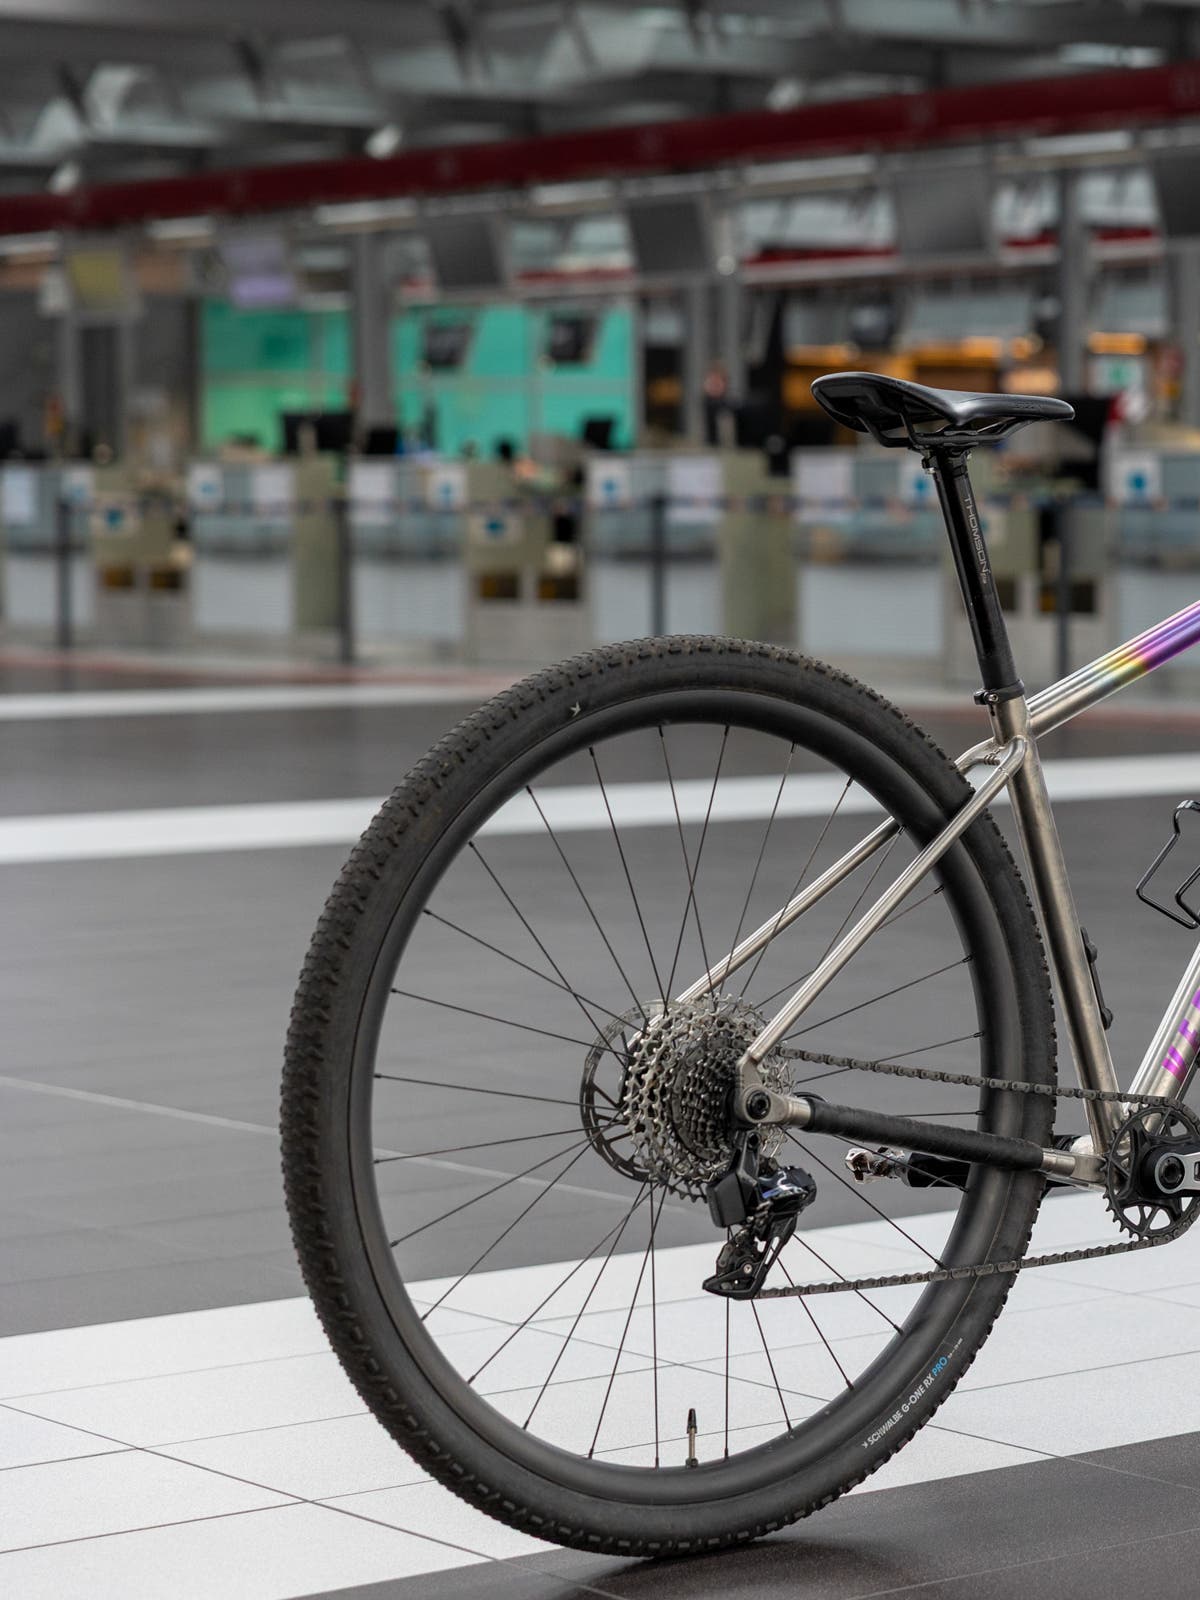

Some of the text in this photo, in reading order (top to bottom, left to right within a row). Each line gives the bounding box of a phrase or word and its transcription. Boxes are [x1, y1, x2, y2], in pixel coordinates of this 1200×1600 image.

[964, 494, 989, 573] THOMSON
[867, 1356, 948, 1445] SCHWALBE G-ONE RX PRO
